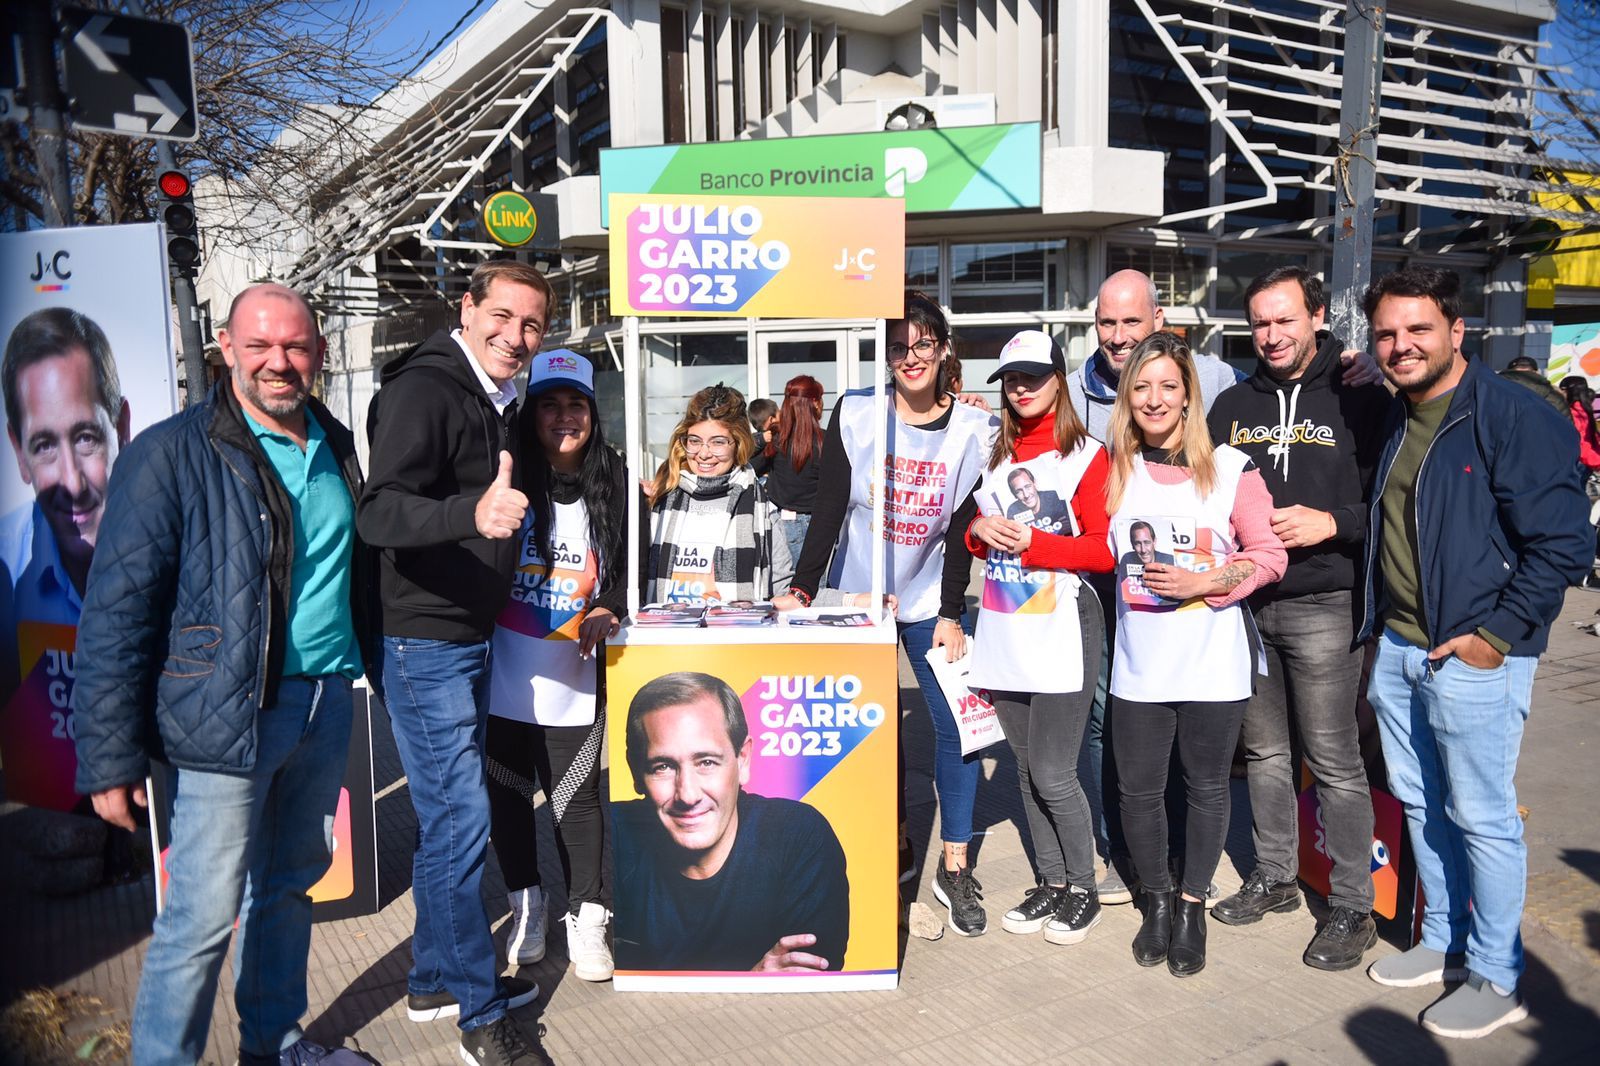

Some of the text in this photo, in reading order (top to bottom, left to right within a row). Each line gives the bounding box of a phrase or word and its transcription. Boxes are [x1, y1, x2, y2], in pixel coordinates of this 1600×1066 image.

[700, 164, 874, 191] Banco Provincia
[637, 203, 764, 235] JULIO
[638, 239, 791, 271] GARRO
[638, 273, 739, 305] 2023
[883, 453, 948, 476] ARRETA
[884, 469, 947, 488] ESIDENTE
[674, 557, 709, 568] UDAD
[683, 546, 699, 557] LA
[509, 586, 587, 612] GARRO
[759, 673, 862, 701] JULIO
[760, 702, 886, 729] GARRO
[759, 730, 842, 757] 2023
